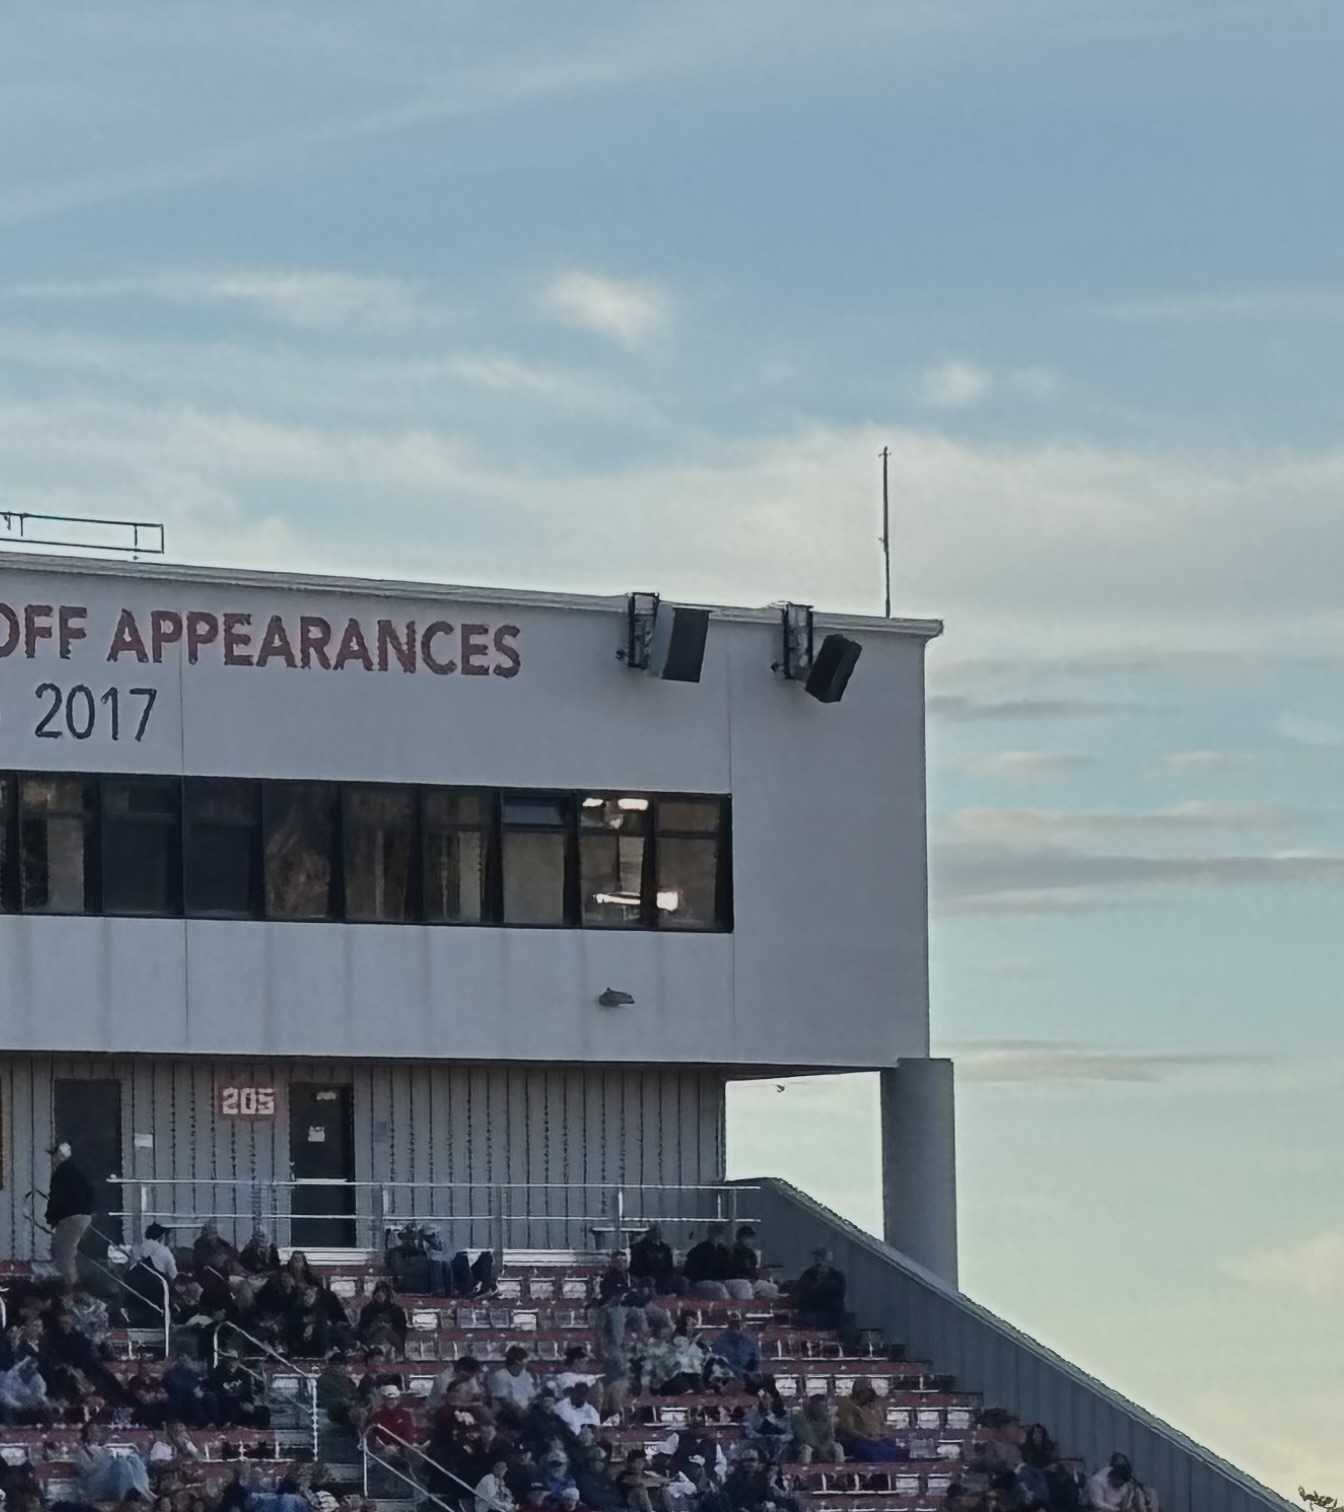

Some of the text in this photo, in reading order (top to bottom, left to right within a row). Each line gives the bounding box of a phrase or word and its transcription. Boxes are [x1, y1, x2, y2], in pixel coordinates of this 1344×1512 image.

[106, 607, 523, 678] APPEARANCES
[34, 683, 158, 743] 2017
[222, 1087, 275, 1115] 205
